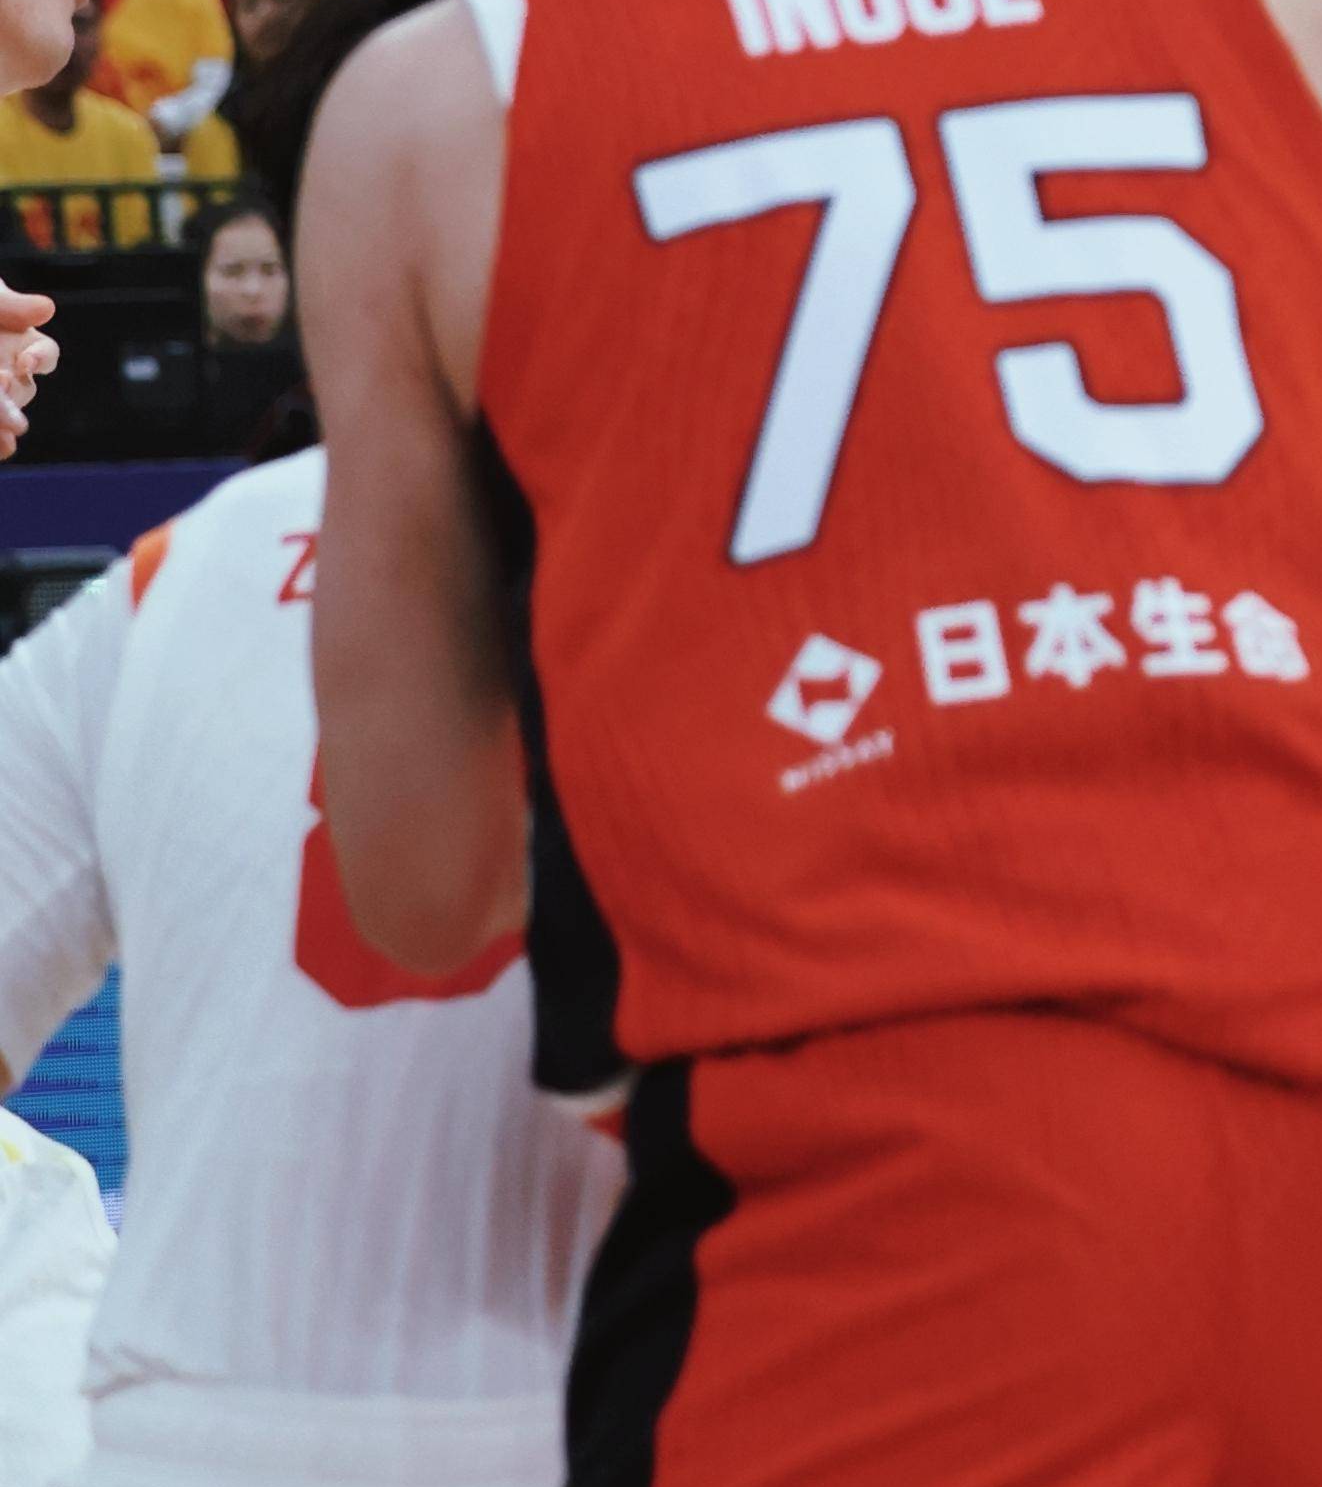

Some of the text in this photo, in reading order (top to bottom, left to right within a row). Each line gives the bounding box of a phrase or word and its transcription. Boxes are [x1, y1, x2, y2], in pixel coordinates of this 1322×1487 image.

[632, 92, 1264, 566] 75
[915, 577, 1312, 707] 日本生命
